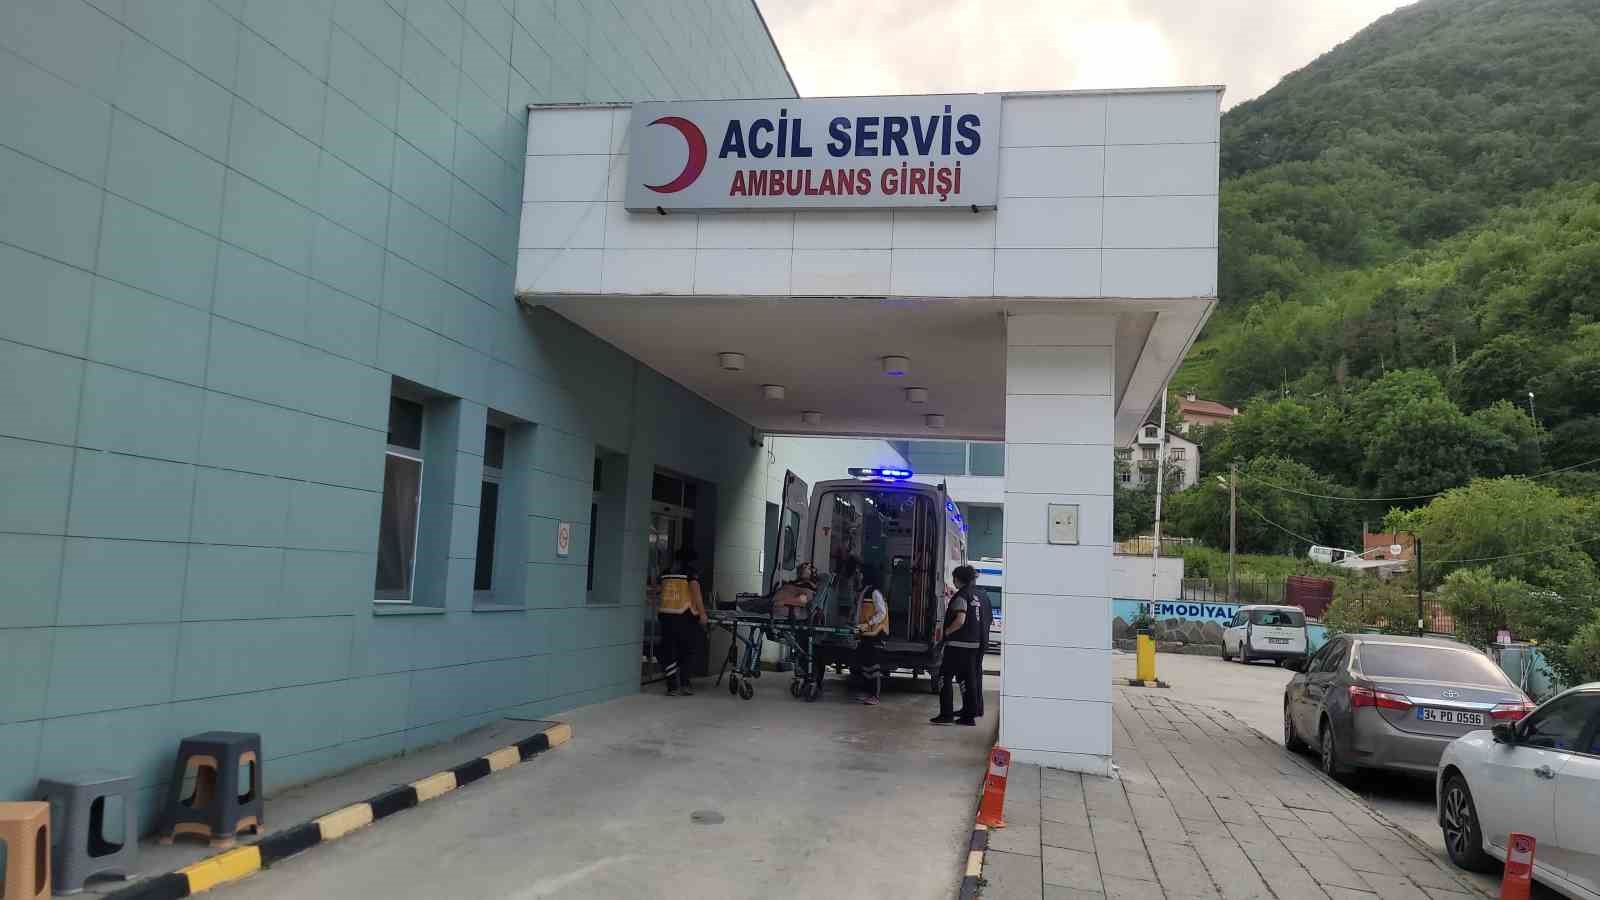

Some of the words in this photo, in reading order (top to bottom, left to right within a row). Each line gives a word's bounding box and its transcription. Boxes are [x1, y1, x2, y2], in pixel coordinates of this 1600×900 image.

[718, 108, 813, 159] ACİL
[827, 104, 981, 158] SERVİS
[729, 167, 872, 197] AMBULANS
[880, 160, 962, 202] GİRİŞİ
[1424, 709, 1436, 721] 34
[1456, 712, 1481, 724] 0596
